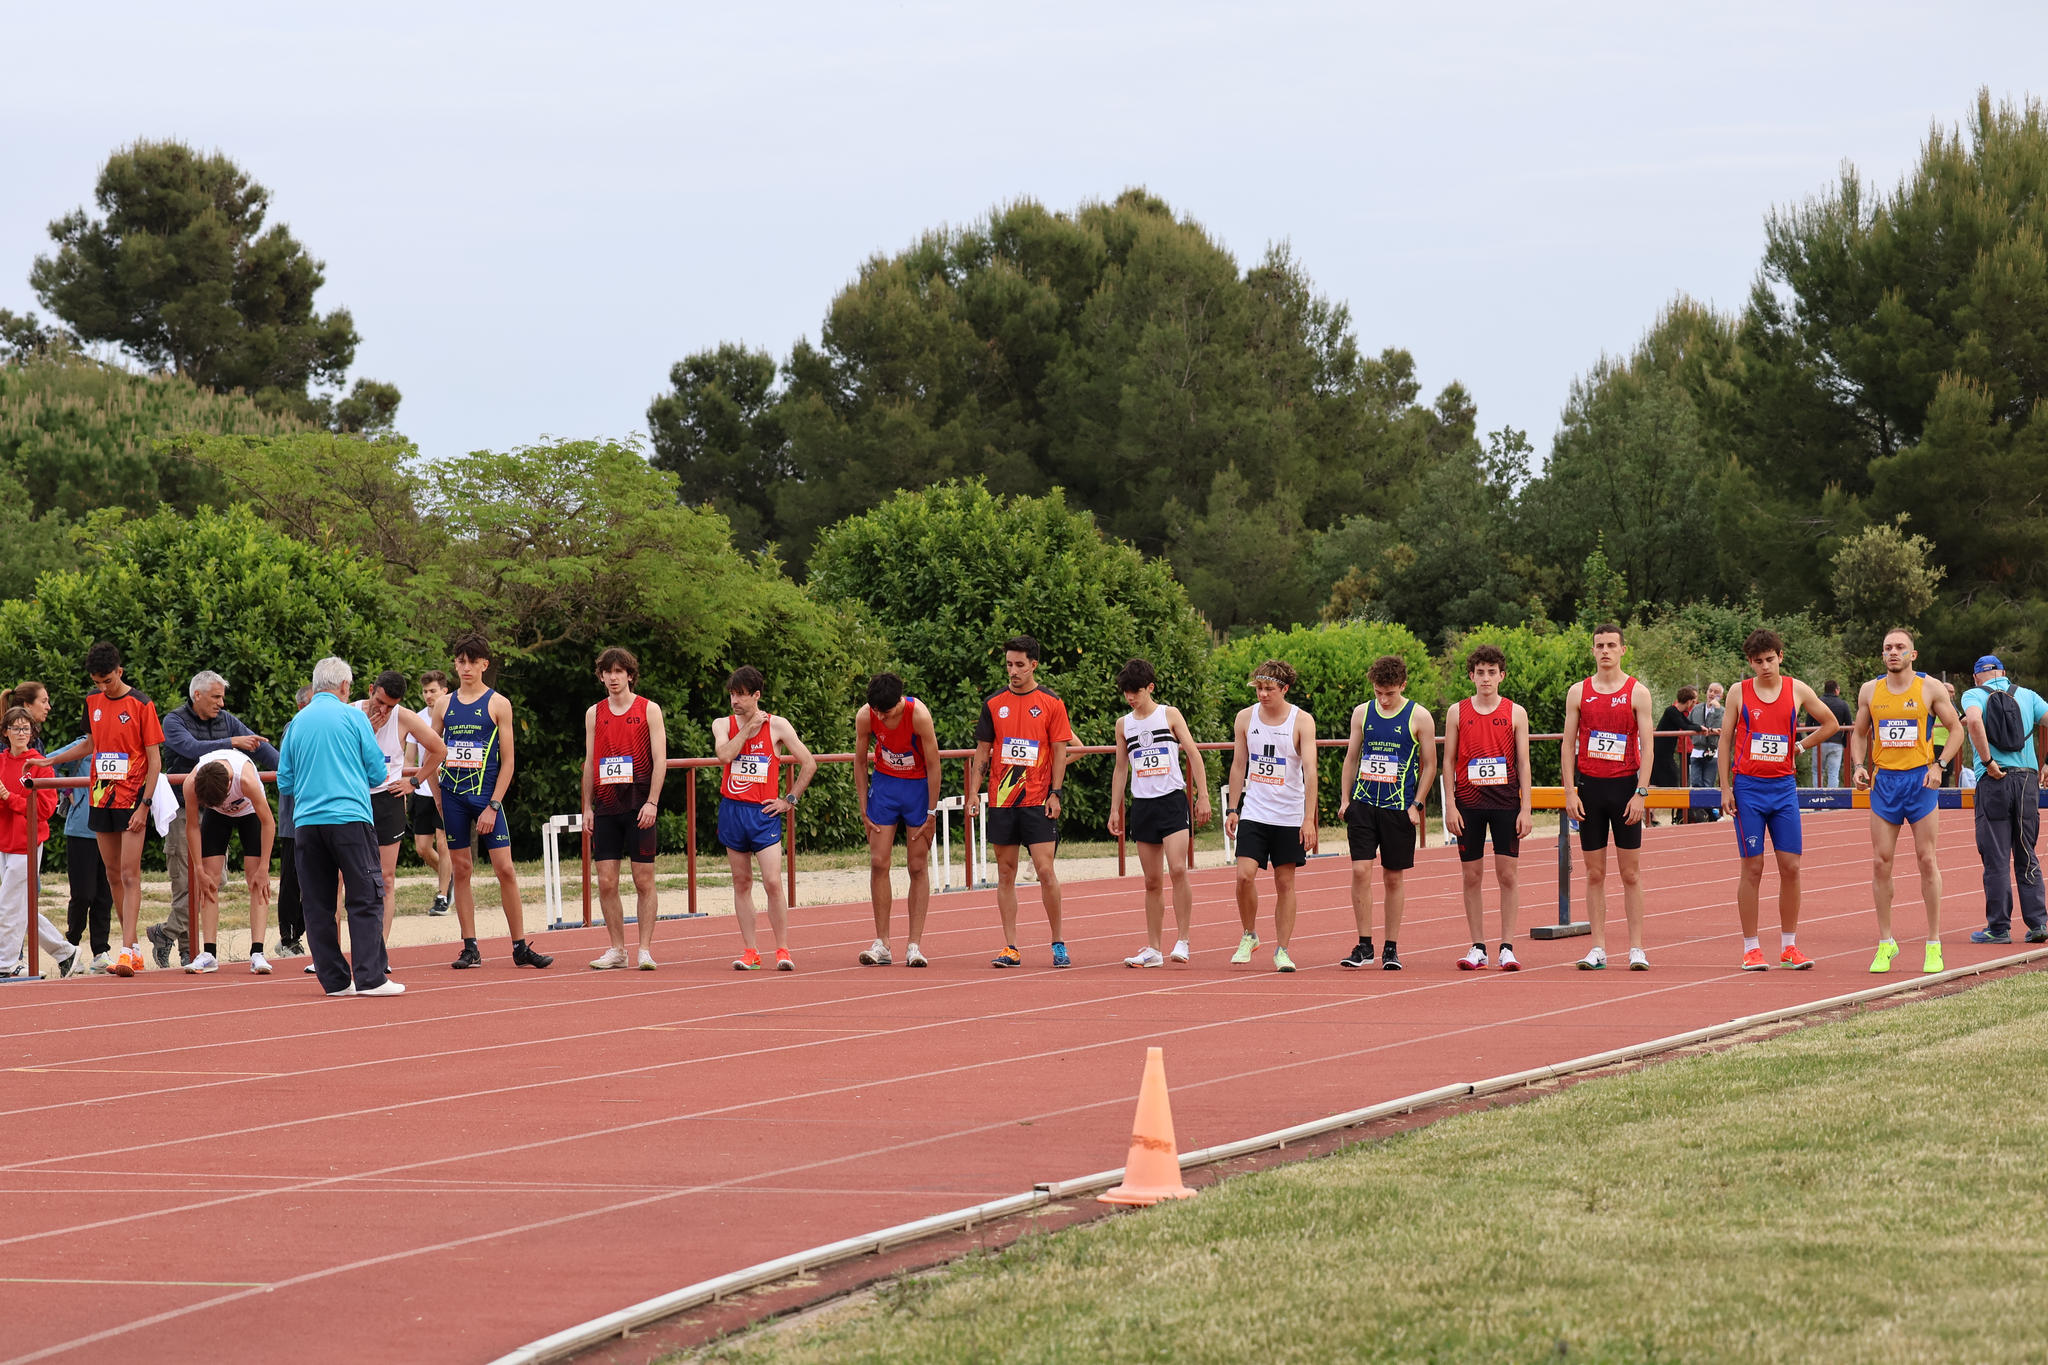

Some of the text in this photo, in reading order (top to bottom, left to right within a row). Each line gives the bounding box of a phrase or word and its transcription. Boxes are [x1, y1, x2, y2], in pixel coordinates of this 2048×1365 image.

[1889, 727, 1906, 740] 67
[1011, 746, 1026, 758] 65
[1598, 740, 1615, 752] 57
[1761, 742, 1778, 754] 53
[456, 748, 471, 760] 56
[102, 760, 116, 771] 66
[1143, 756, 1159, 768] 49
[1370, 762, 1386, 774] 55
[607, 764, 622, 776] 64
[741, 763, 757, 774] 58
[1258, 763, 1274, 776] 59
[1479, 765, 1496, 777] 63
